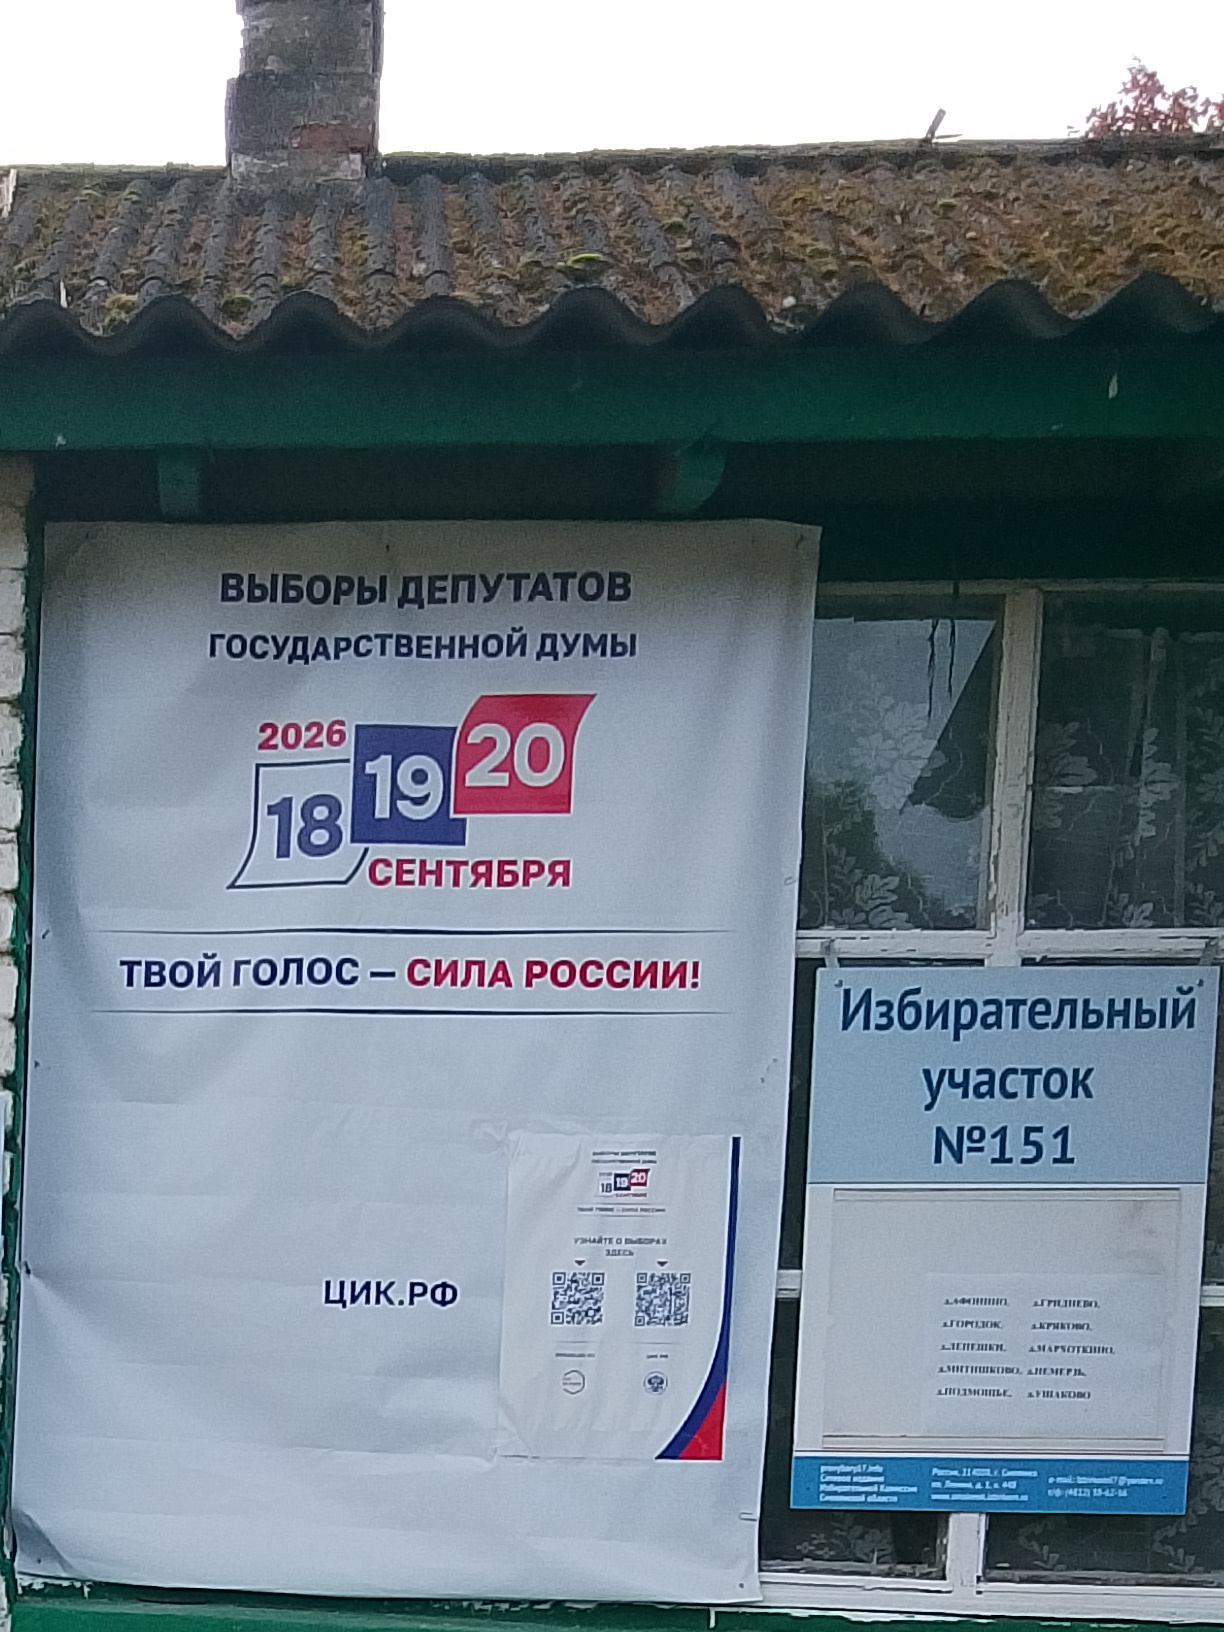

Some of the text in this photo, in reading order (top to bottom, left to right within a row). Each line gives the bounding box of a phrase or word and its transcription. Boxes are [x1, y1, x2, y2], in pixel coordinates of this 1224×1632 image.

[221, 571, 631, 609] ВЫБОРЫ ДЕПУТАТОВ
[210, 626, 636, 665] ГОСУДАРСТВЕННОЙ ДУМЫ
[259, 720, 346, 750] 2026
[463, 722, 566, 788] 20
[363, 753, 445, 822] 19
[266, 793, 344, 859] 18
[369, 858, 570, 887] СЕНТЯБРЯ
[120, 953, 221, 988] ТВОЙ
[233, 958, 358, 986] ГОЛОС
[407, 959, 512, 987] СИЛА
[526, 960, 698, 988] РОССИИ!
[841, 985, 1195, 1041] Избирательный
[923, 1068, 1094, 1111] участок
[934, 1125, 1075, 1164] №151
[601, 1182, 612, 1193] 18
[630, 1172, 646, 1183] 20
[574, 1236, 613, 1245] УЗНАЙТЕ
[325, 1281, 457, 1308] ЦИК.РФ
